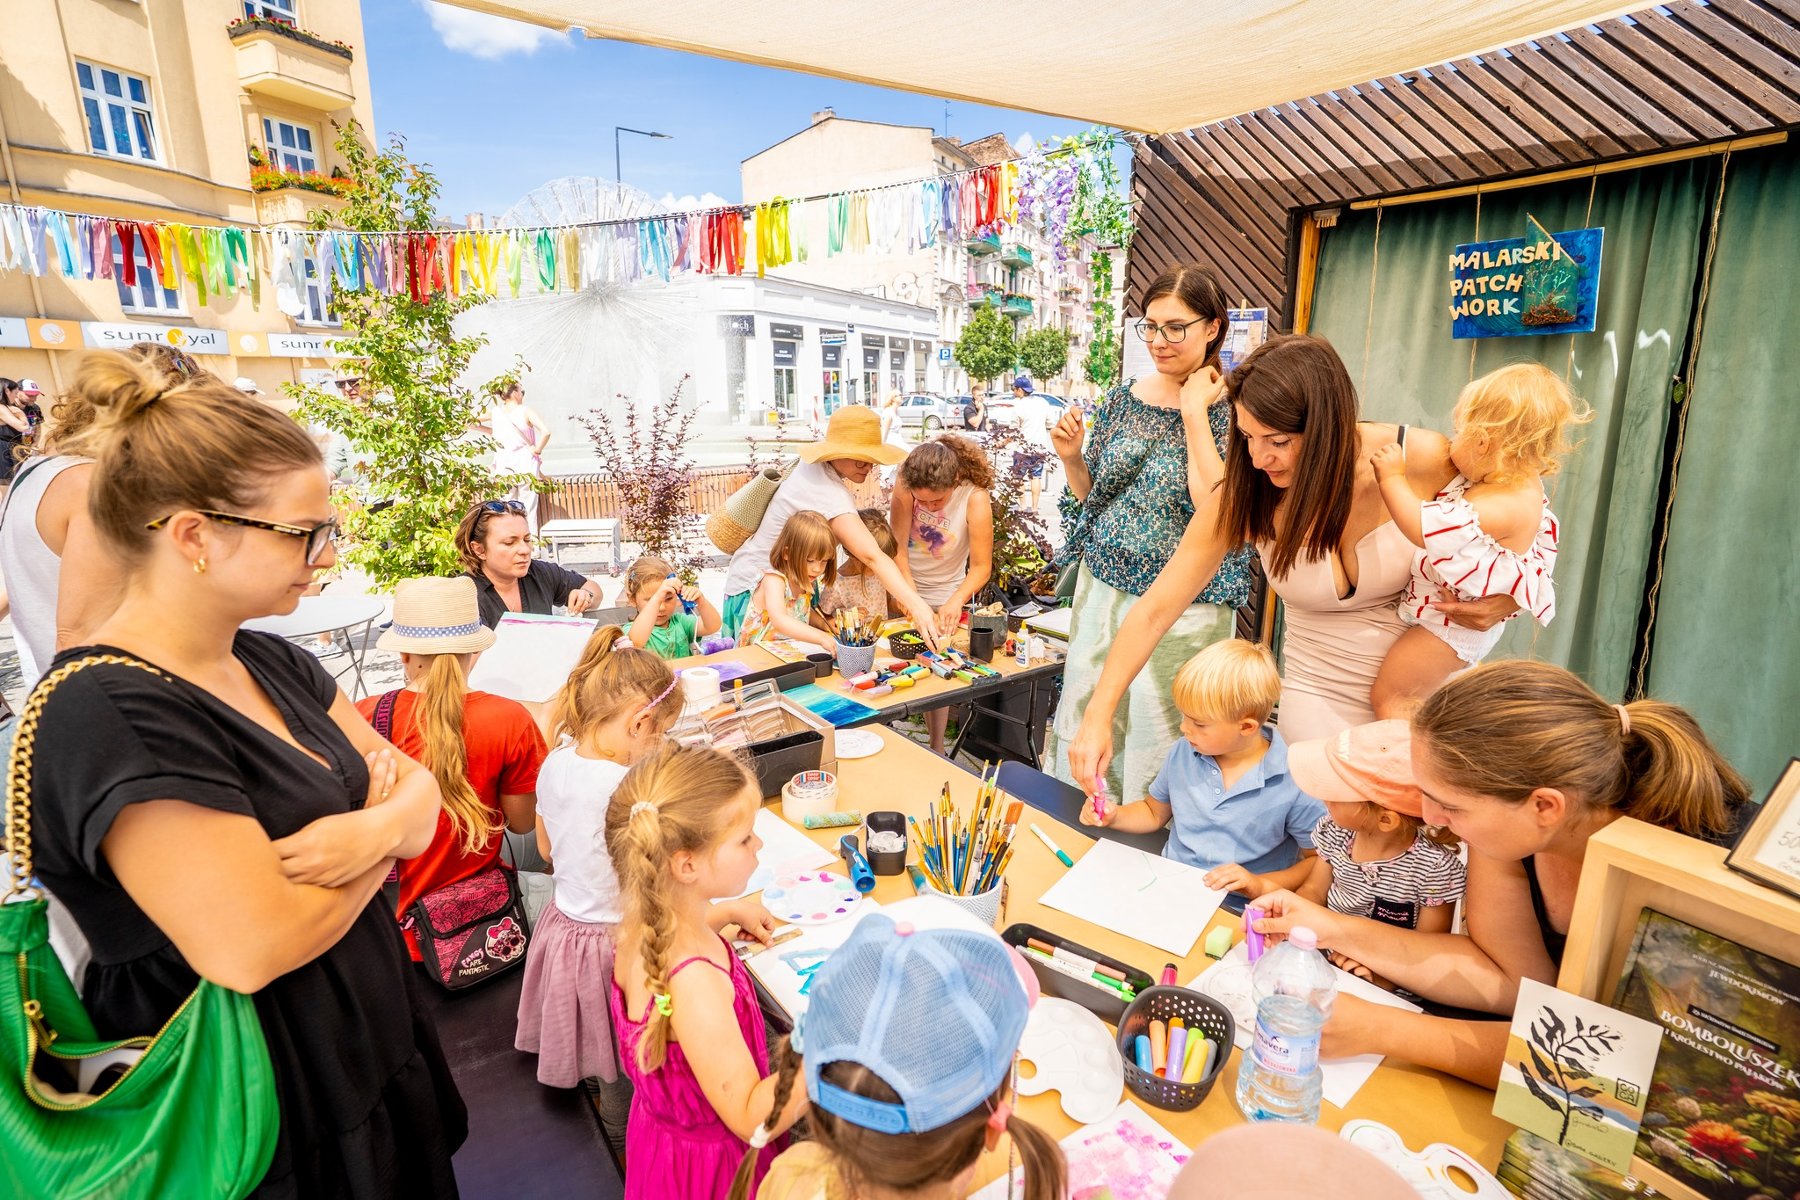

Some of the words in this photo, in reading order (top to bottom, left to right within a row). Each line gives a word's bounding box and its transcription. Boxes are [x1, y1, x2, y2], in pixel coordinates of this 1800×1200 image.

[1449, 241, 1561, 272] MALARSKI
[1450, 273, 1524, 297] PATCH
[1449, 297, 1520, 321] WORK
[941, 349, 950, 360] P
[919, 512, 949, 528] CTIVE
[458, 963, 490, 977] FANTASTIC
[1660, 1010, 1800, 1090] BOMBOLUSZEK
